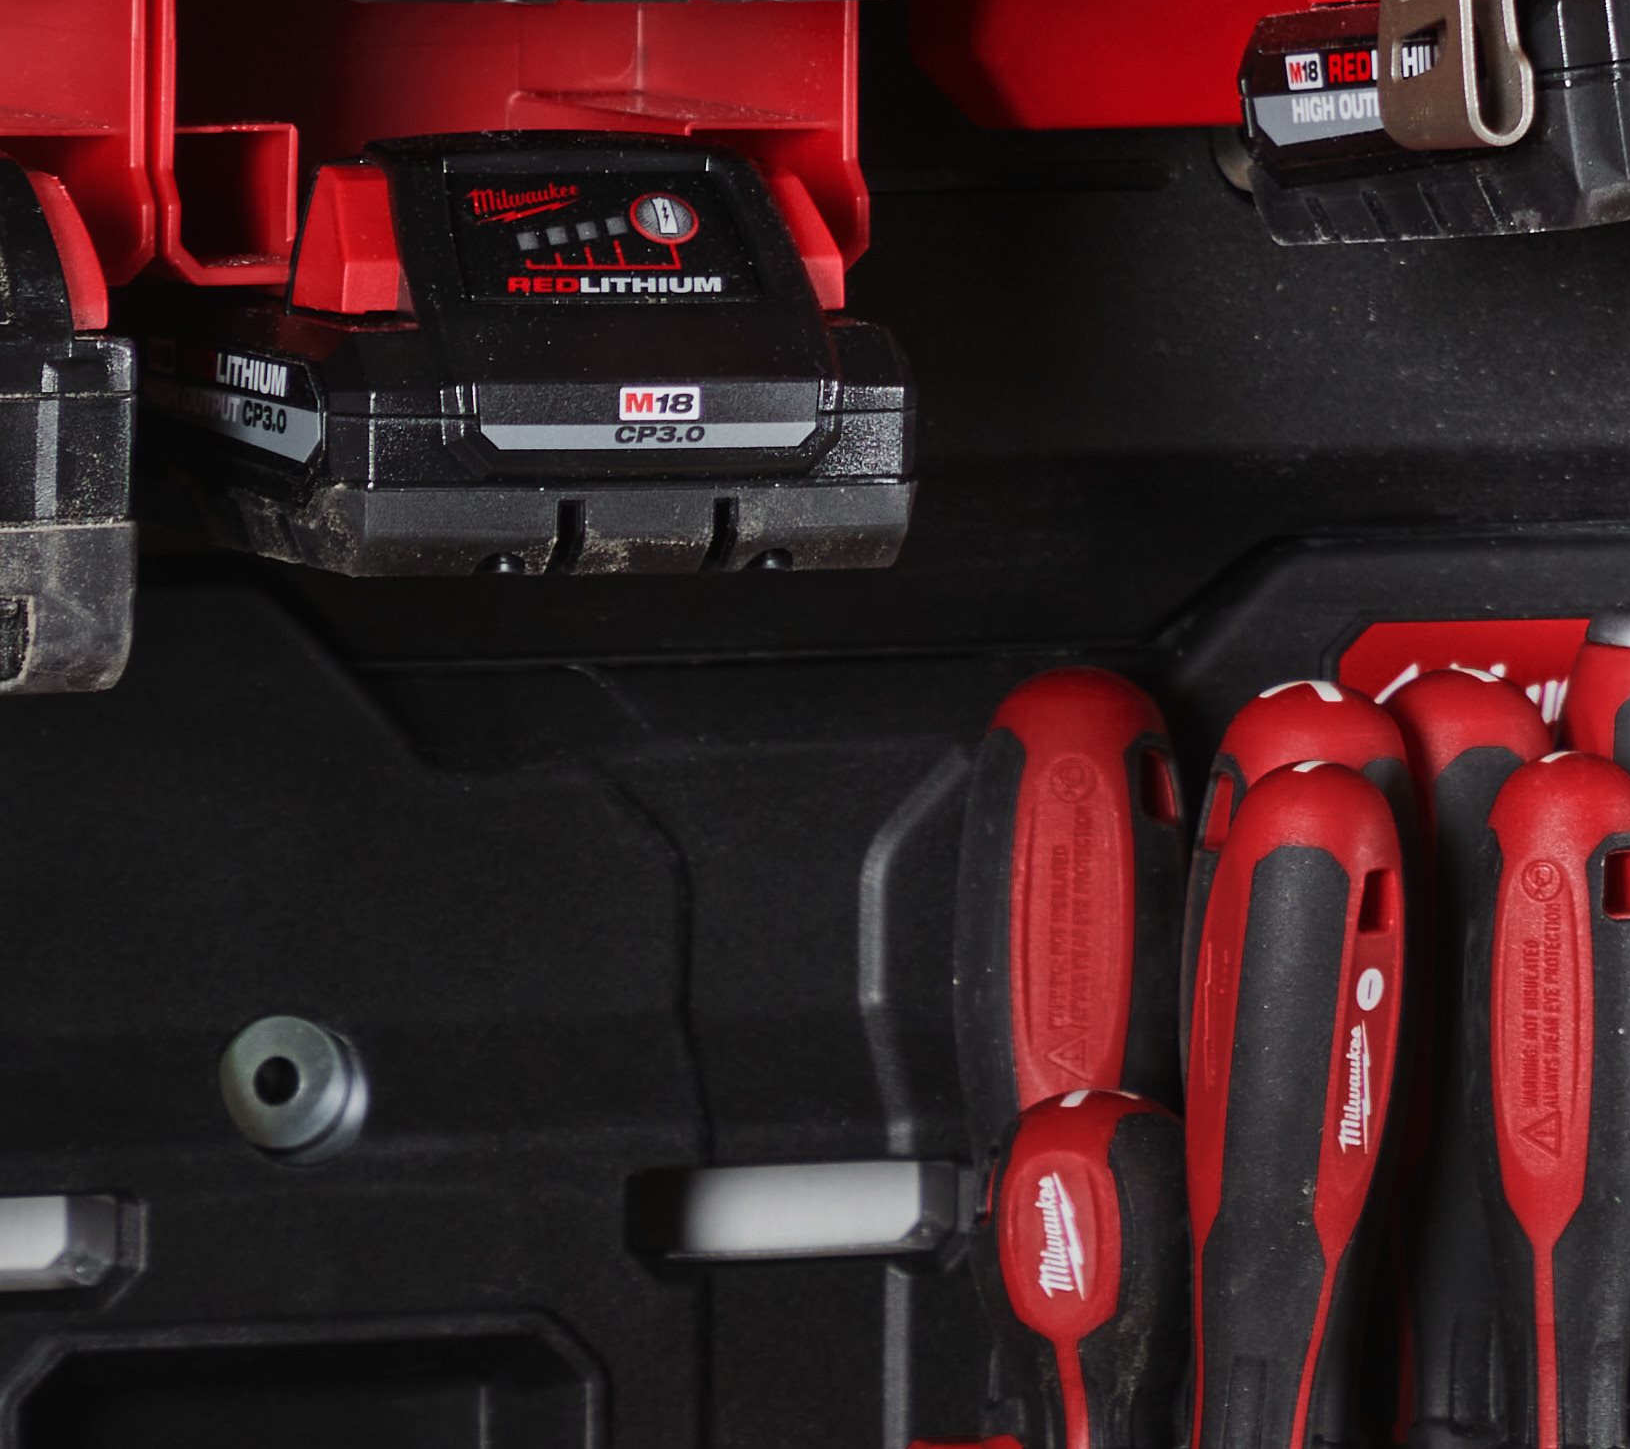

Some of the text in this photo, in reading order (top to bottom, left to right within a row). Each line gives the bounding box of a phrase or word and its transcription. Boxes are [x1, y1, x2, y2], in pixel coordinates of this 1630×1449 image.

[1288, 59, 1319, 84] M18
[1291, 94, 1336, 124] HIGH
[466, 182, 580, 216] Milwaukee
[507, 276, 723, 294] REDLITHIUM
[625, 392, 694, 414] M18
[242, 400, 288, 435] CP3.0
[614, 425, 706, 444] CP3.0
[1543, 988, 1560, 1013] EYE
[1337, 1024, 1363, 1154] Milwaukee
[1034, 1175, 1075, 1298] Milwaukee
